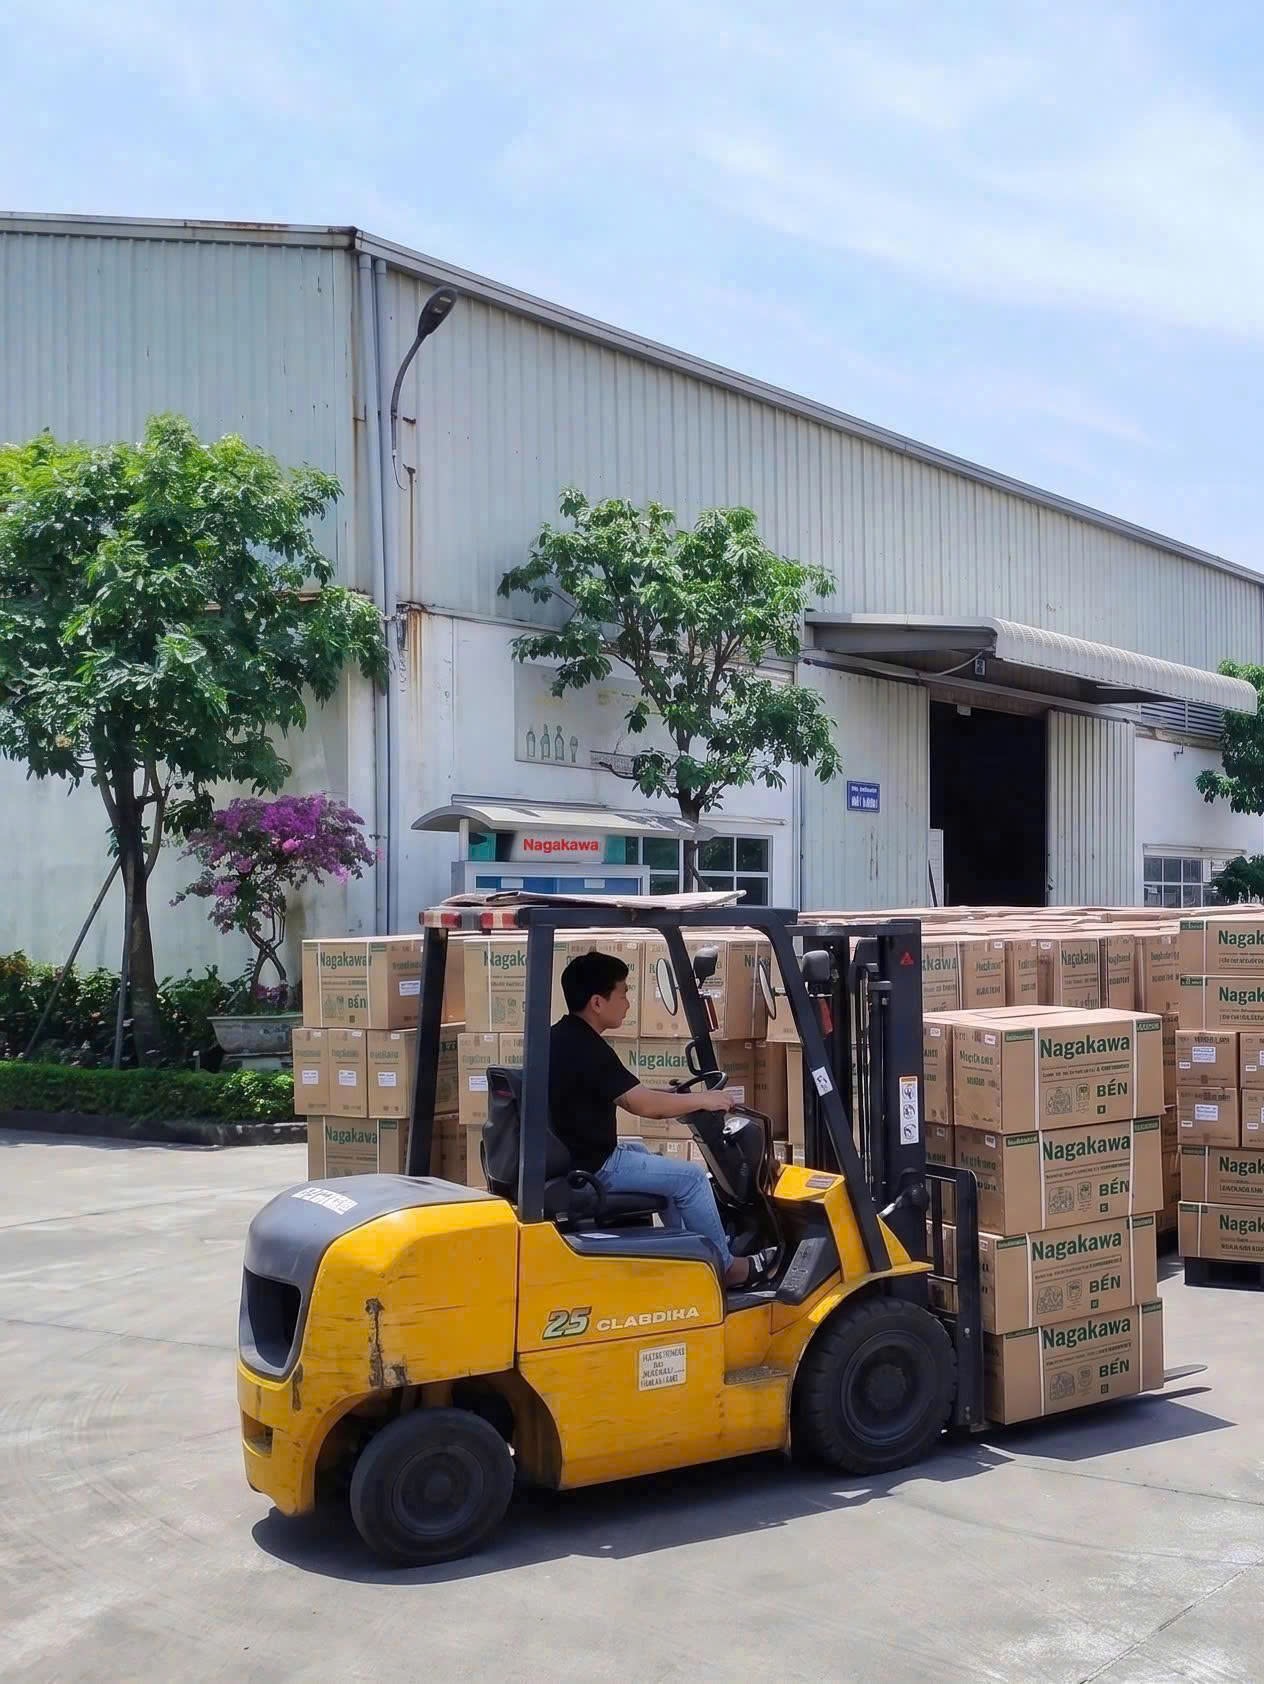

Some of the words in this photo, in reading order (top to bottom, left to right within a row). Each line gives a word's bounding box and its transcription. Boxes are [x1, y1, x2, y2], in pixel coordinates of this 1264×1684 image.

[523, 838, 599, 854] Nagakawa
[1040, 1034, 1130, 1060] Nagakawa
[1096, 1078, 1129, 1098] BÉN
[1042, 1133, 1131, 1162] Nagakawa
[1031, 1231, 1122, 1262] Nagakawa
[1089, 1273, 1121, 1294] BÉN
[542, 1306, 593, 1341] 25
[1042, 1317, 1131, 1350] Nagakawa
[1099, 1357, 1130, 1378] BÉN
